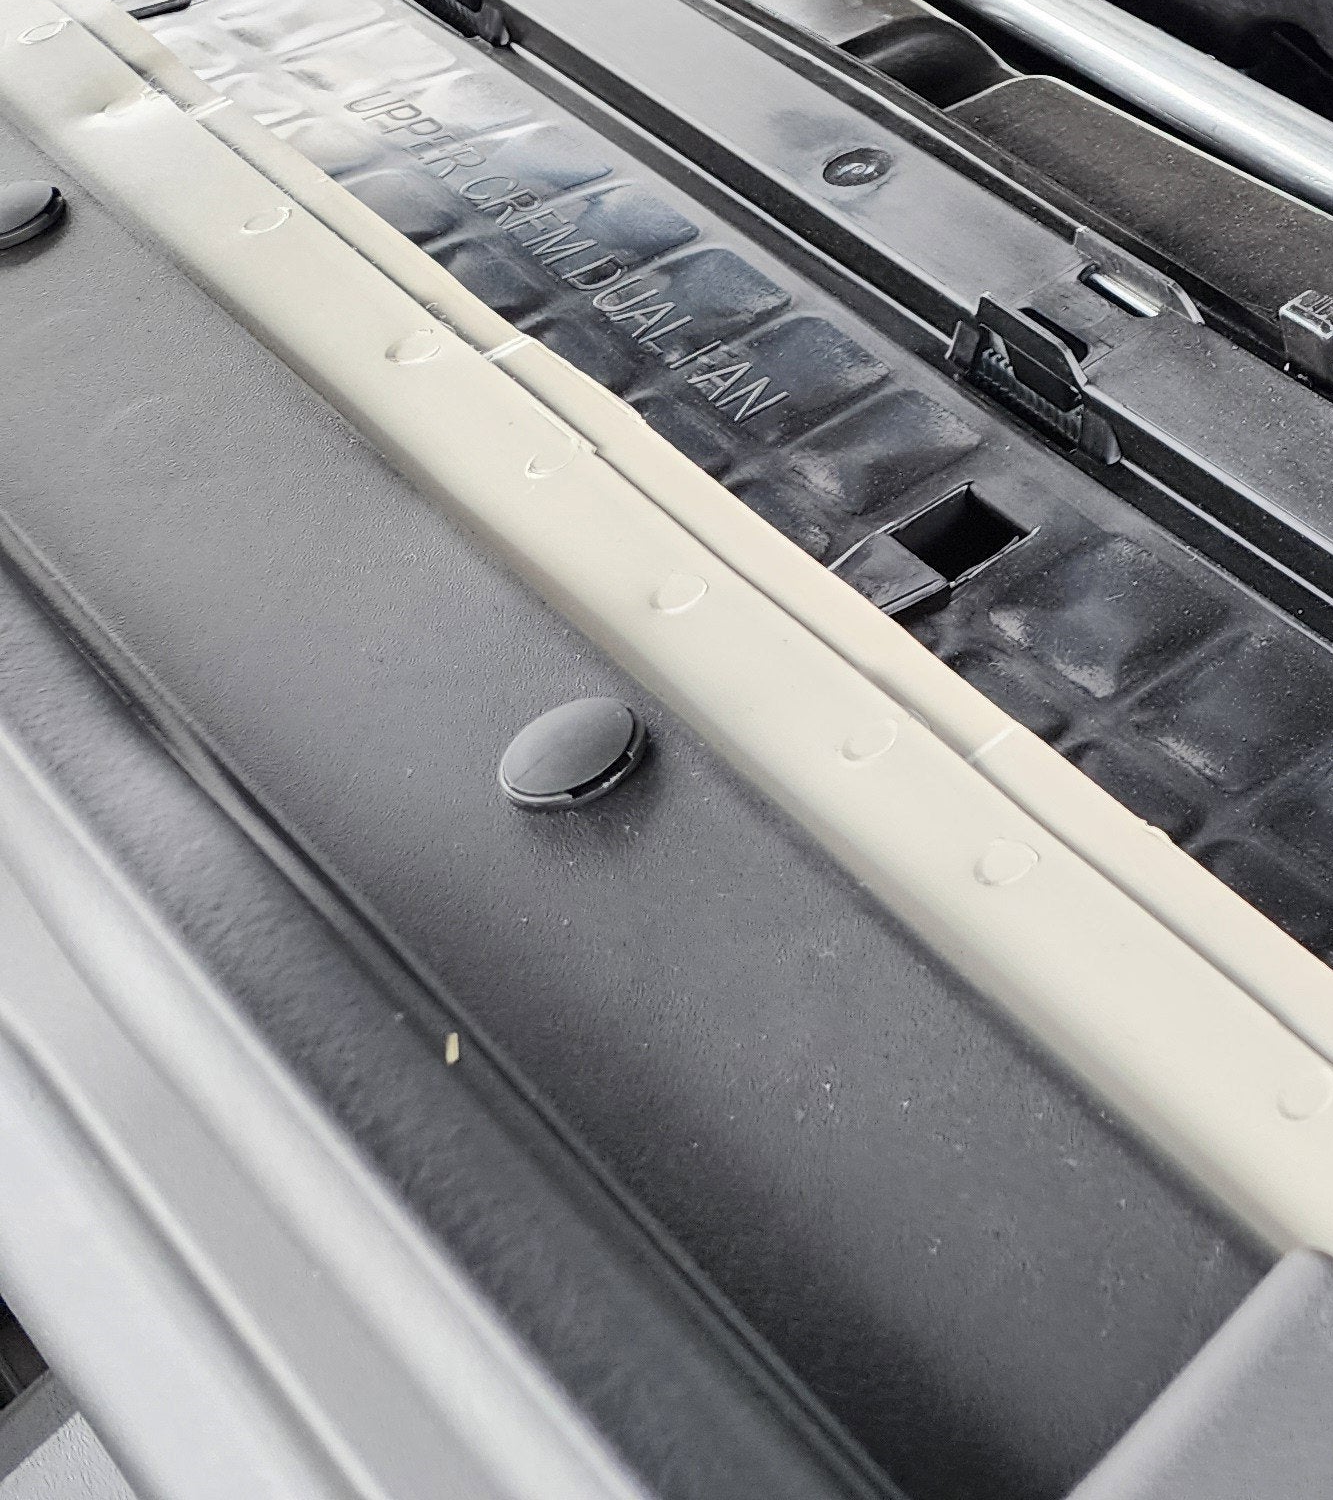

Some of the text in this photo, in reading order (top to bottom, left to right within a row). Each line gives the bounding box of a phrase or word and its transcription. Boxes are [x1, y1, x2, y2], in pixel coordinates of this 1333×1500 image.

[344, 90, 487, 178] UPPER
[561, 253, 695, 355] DUAL
[668, 340, 791, 425] FAN
